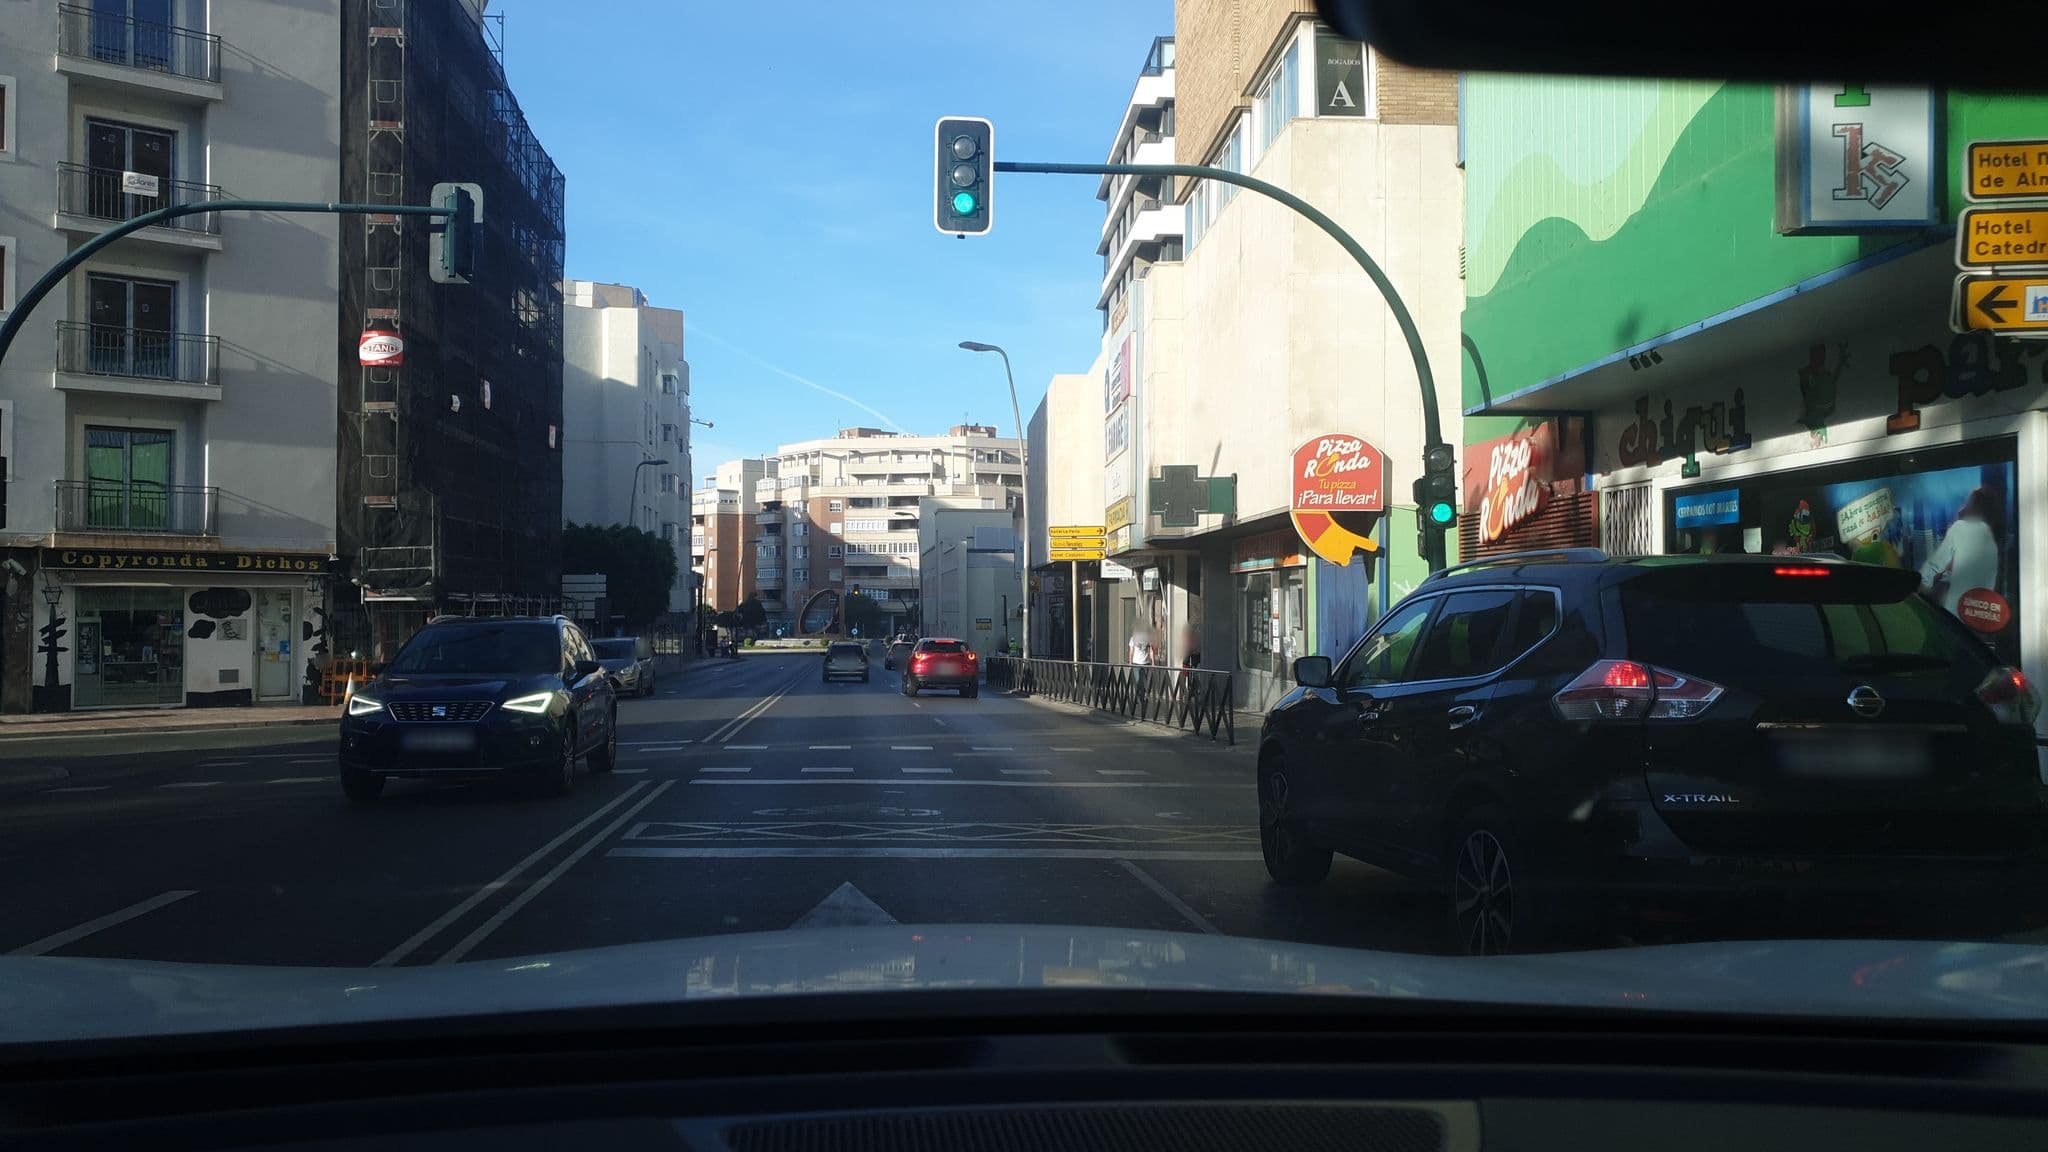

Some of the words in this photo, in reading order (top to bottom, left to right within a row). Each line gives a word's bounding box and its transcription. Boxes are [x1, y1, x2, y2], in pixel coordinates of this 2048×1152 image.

[1328, 80, 1356, 107] A
[1978, 152, 2028, 168] Hotel
[1980, 174, 2004, 188] de
[1975, 219, 2032, 236] Hotel
[1975, 240, 2047, 257] Catedr
[1886, 327, 2048, 436] par
[1315, 439, 1363, 459] Pizza
[1303, 452, 1372, 479] Ronda
[1488, 438, 1532, 493] Pizza
[1319, 479, 1330, 489] Tu
[1331, 480, 1357, 492] pizza
[1335, 489, 1378, 505] llevar!
[61, 551, 208, 569] Copyronda
[236, 555, 320, 571] Dichos
[1663, 794, 1740, 803] X-TRAIL
